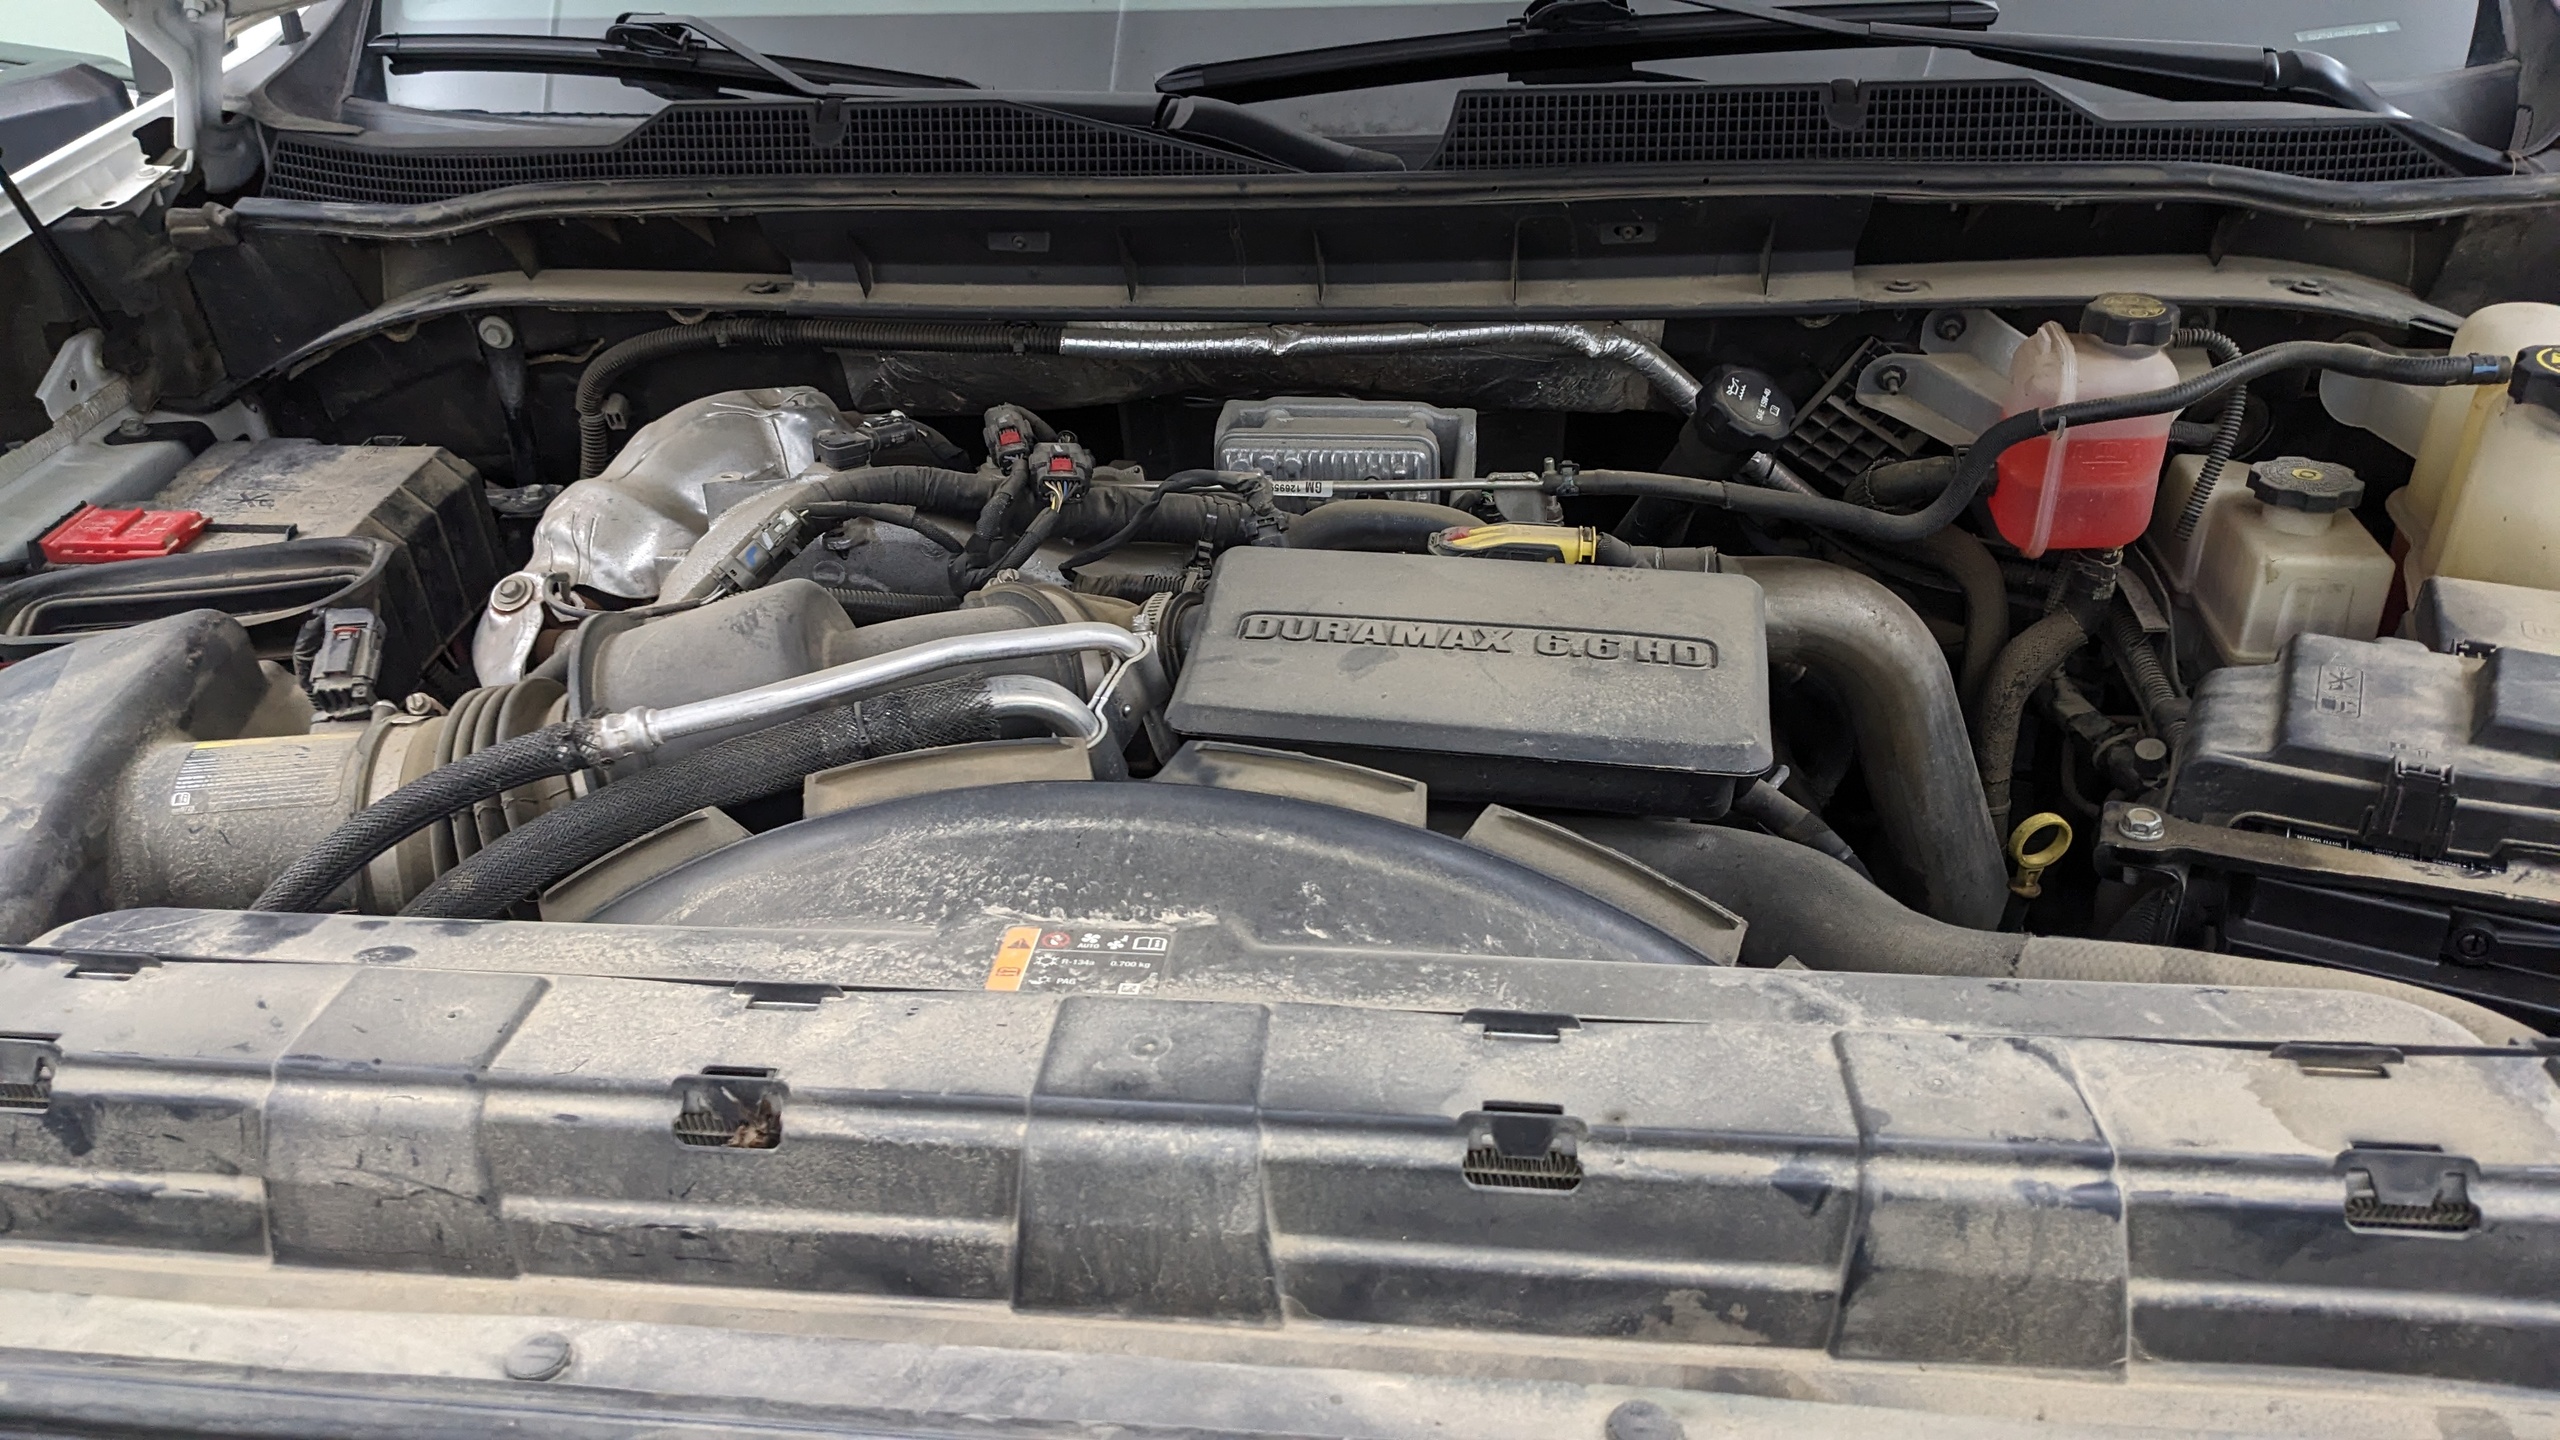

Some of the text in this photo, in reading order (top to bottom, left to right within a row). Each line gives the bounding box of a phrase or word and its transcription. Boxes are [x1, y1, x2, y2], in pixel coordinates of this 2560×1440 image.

[1756, 409, 1765, 421] SAE
[1305, 482, 1322, 493] GM
[1243, 616, 1710, 668] DURAMAX 6.6 HD
[2323, 839, 2342, 847] WITH
[1061, 958, 1096, 966] R-134a
[1138, 961, 1151, 969] kg
[1056, 977, 1076, 985] PAG
